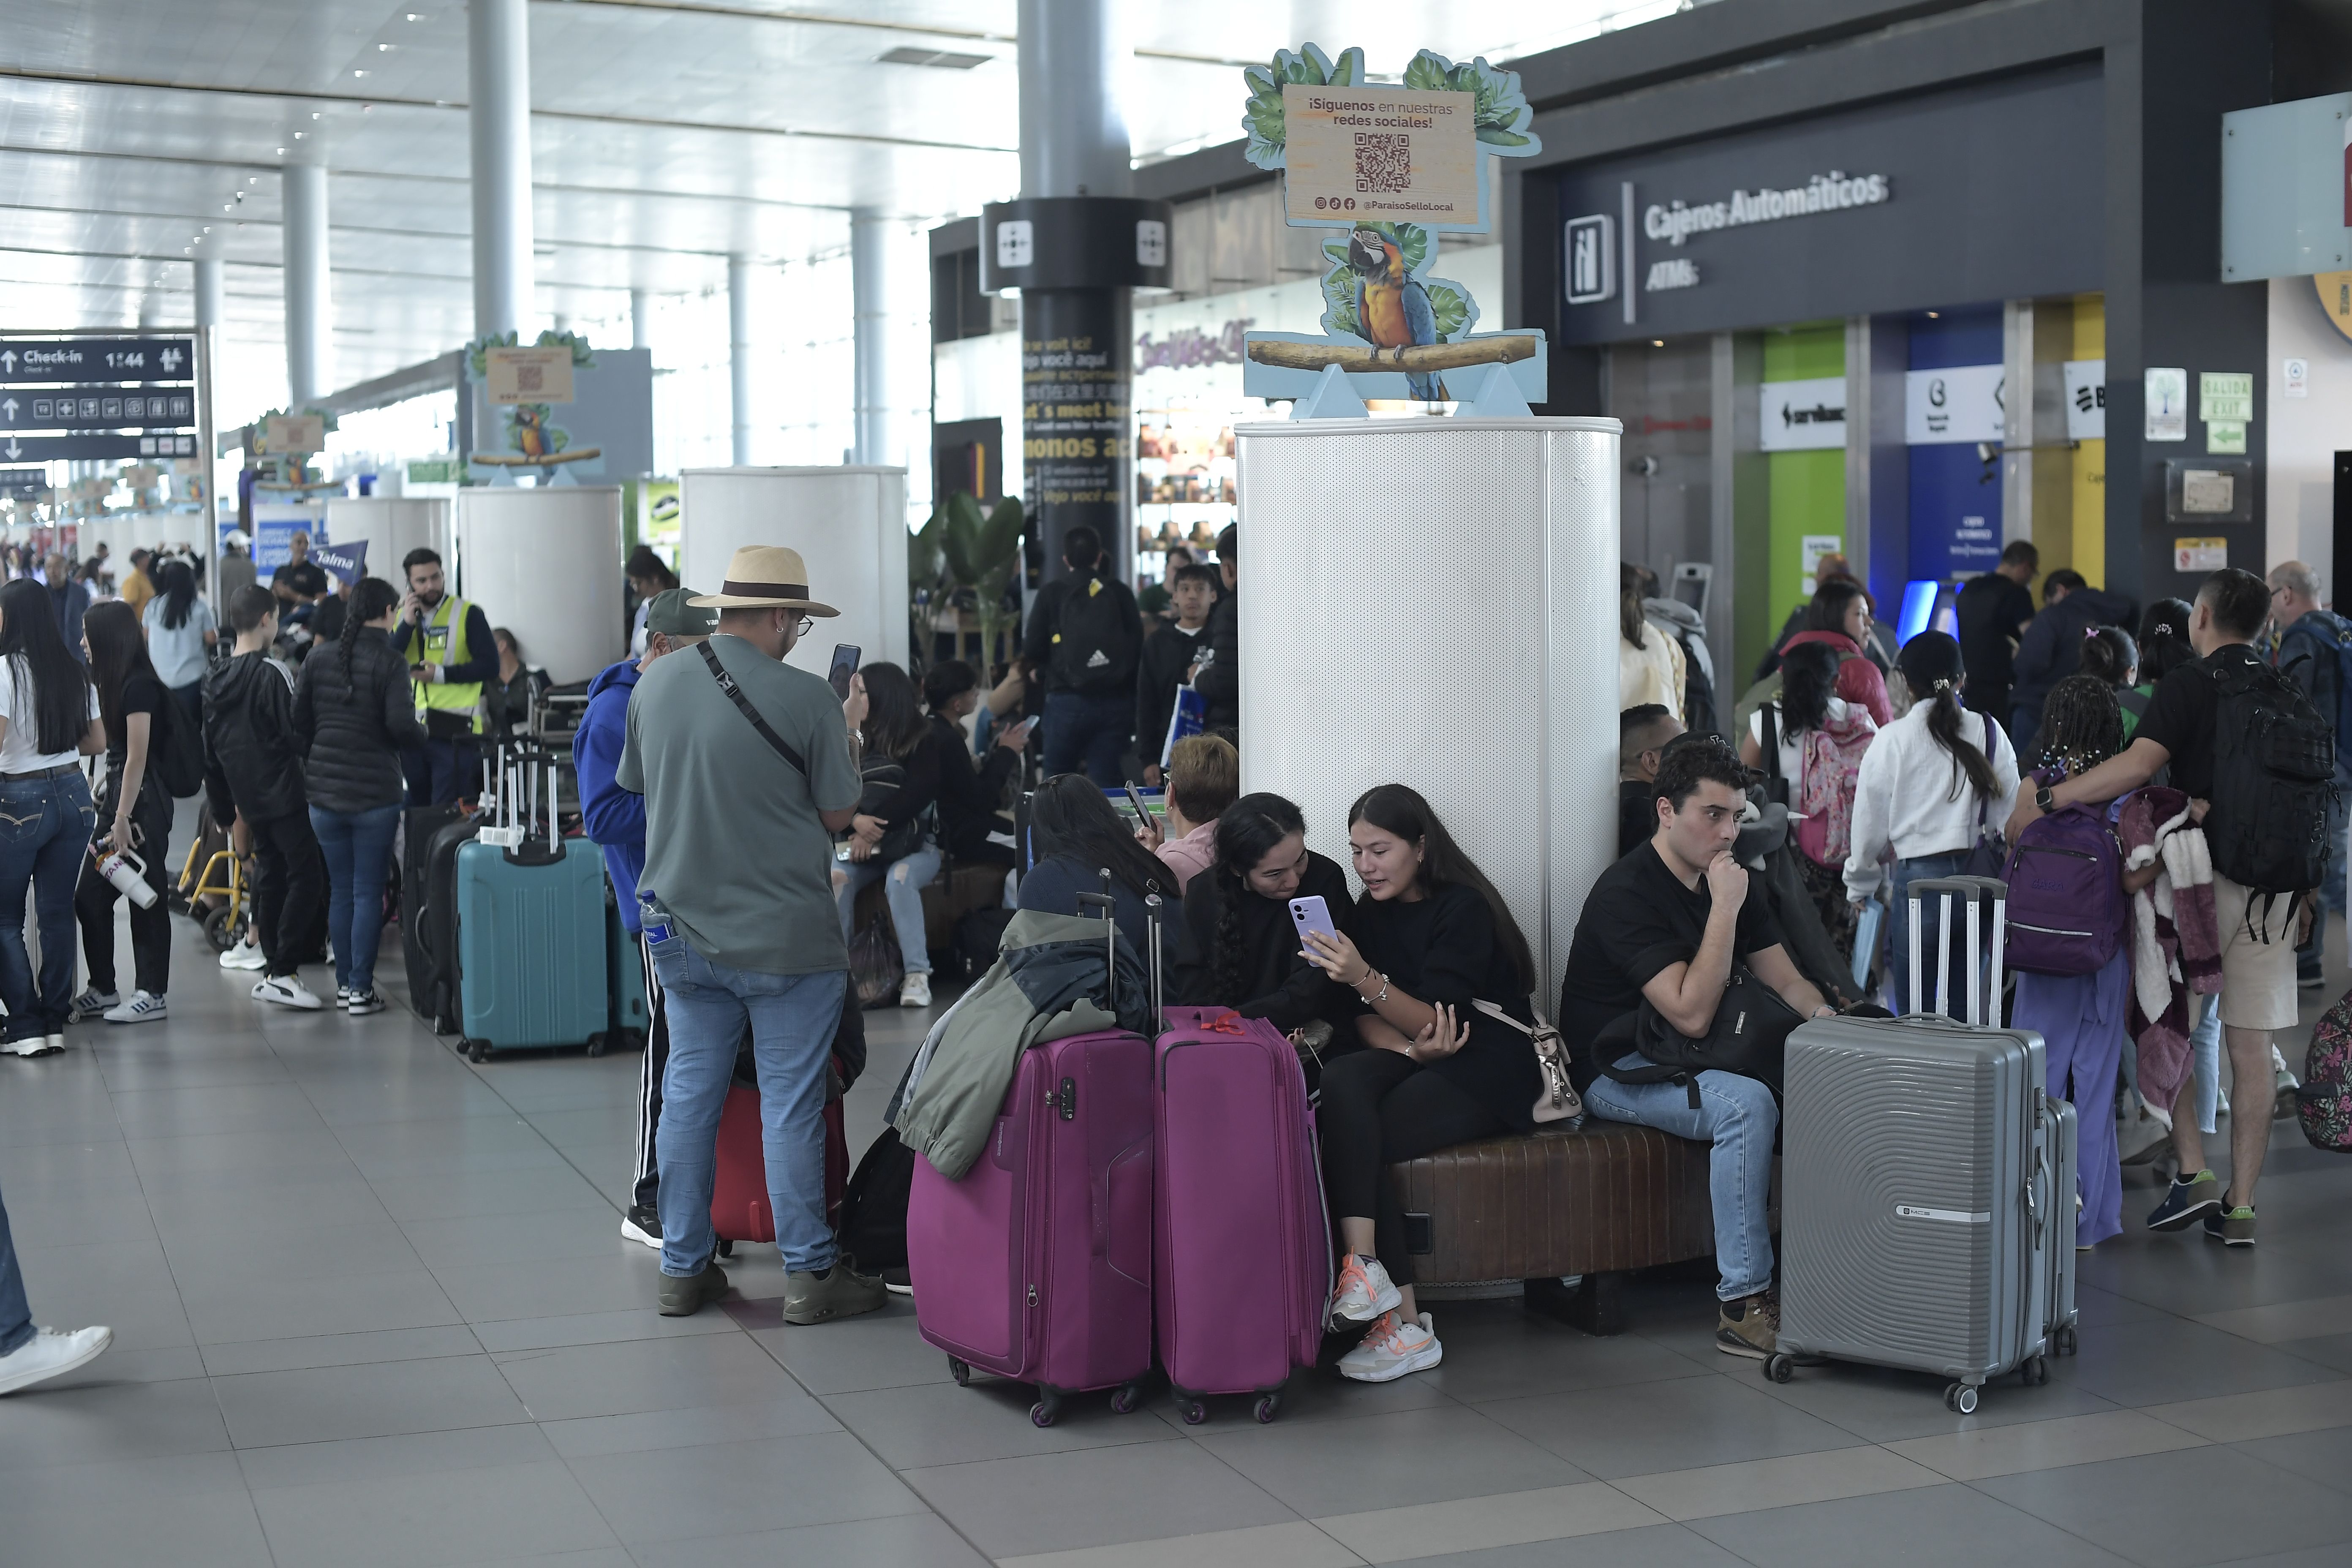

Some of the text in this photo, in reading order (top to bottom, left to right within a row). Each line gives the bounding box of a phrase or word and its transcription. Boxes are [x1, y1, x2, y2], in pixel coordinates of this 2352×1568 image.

[1309, 98, 1453, 115] ¡Síguenos en nuestras
[1334, 114, 1432, 129] redes sociales!
[1364, 201, 1454, 211] @ParaisoSelloLocal
[1644, 170, 1889, 247] Cajeros Automáticos
[1645, 258, 1699, 291] ATMs
[23, 348, 145, 369] Check-in 1:44
[2205, 381, 2249, 394] SALIDA
[2213, 400, 2240, 414] EXIT
[317, 550, 354, 570] Talma
